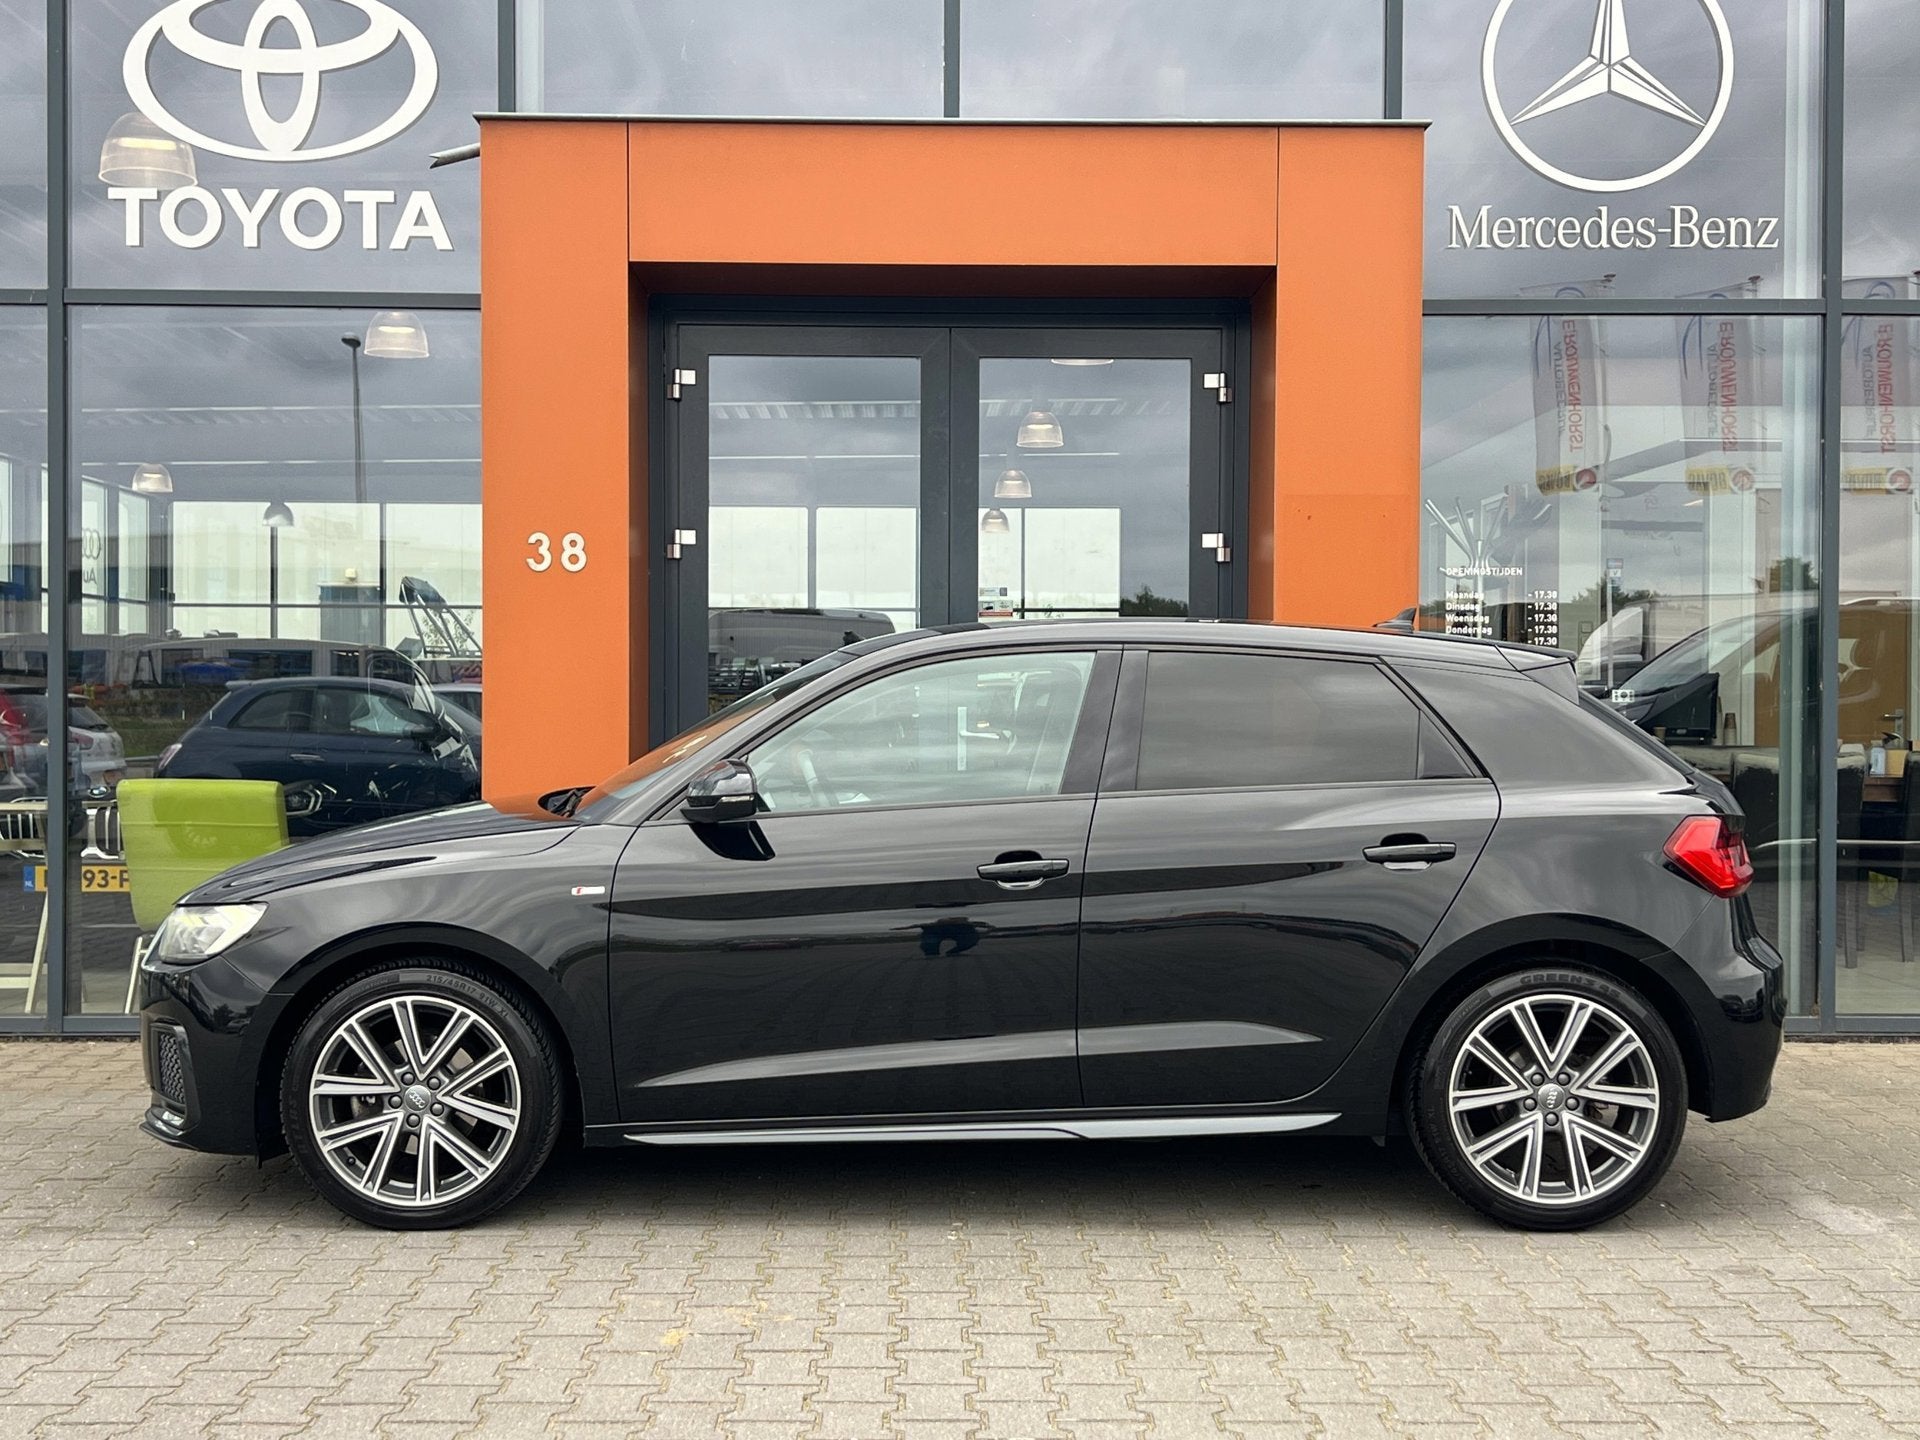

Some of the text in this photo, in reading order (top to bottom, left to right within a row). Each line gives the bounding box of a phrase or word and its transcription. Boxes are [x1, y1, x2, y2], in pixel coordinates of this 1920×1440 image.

[107, 186, 454, 251] TOYOTA
[1447, 204, 1780, 249] Mercedes-Benz
[525, 531, 588, 573] 38
[1446, 567, 1523, 576] OPENINGSTIJDEN
[1446, 591, 1485, 601] Maandag
[1534, 590, 1558, 599] 17.30
[1446, 602, 1481, 612] Dinsdag
[1534, 602, 1558, 611] 17.30
[1445, 614, 1490, 624] Woensdag
[1534, 614, 1558, 622] 17.30
[1446, 626, 1493, 636] Donderdag
[1534, 625, 1558, 634] 17.30
[1534, 637, 1558, 645] 17.30
[426, 974, 477, 995] 215/45R17
